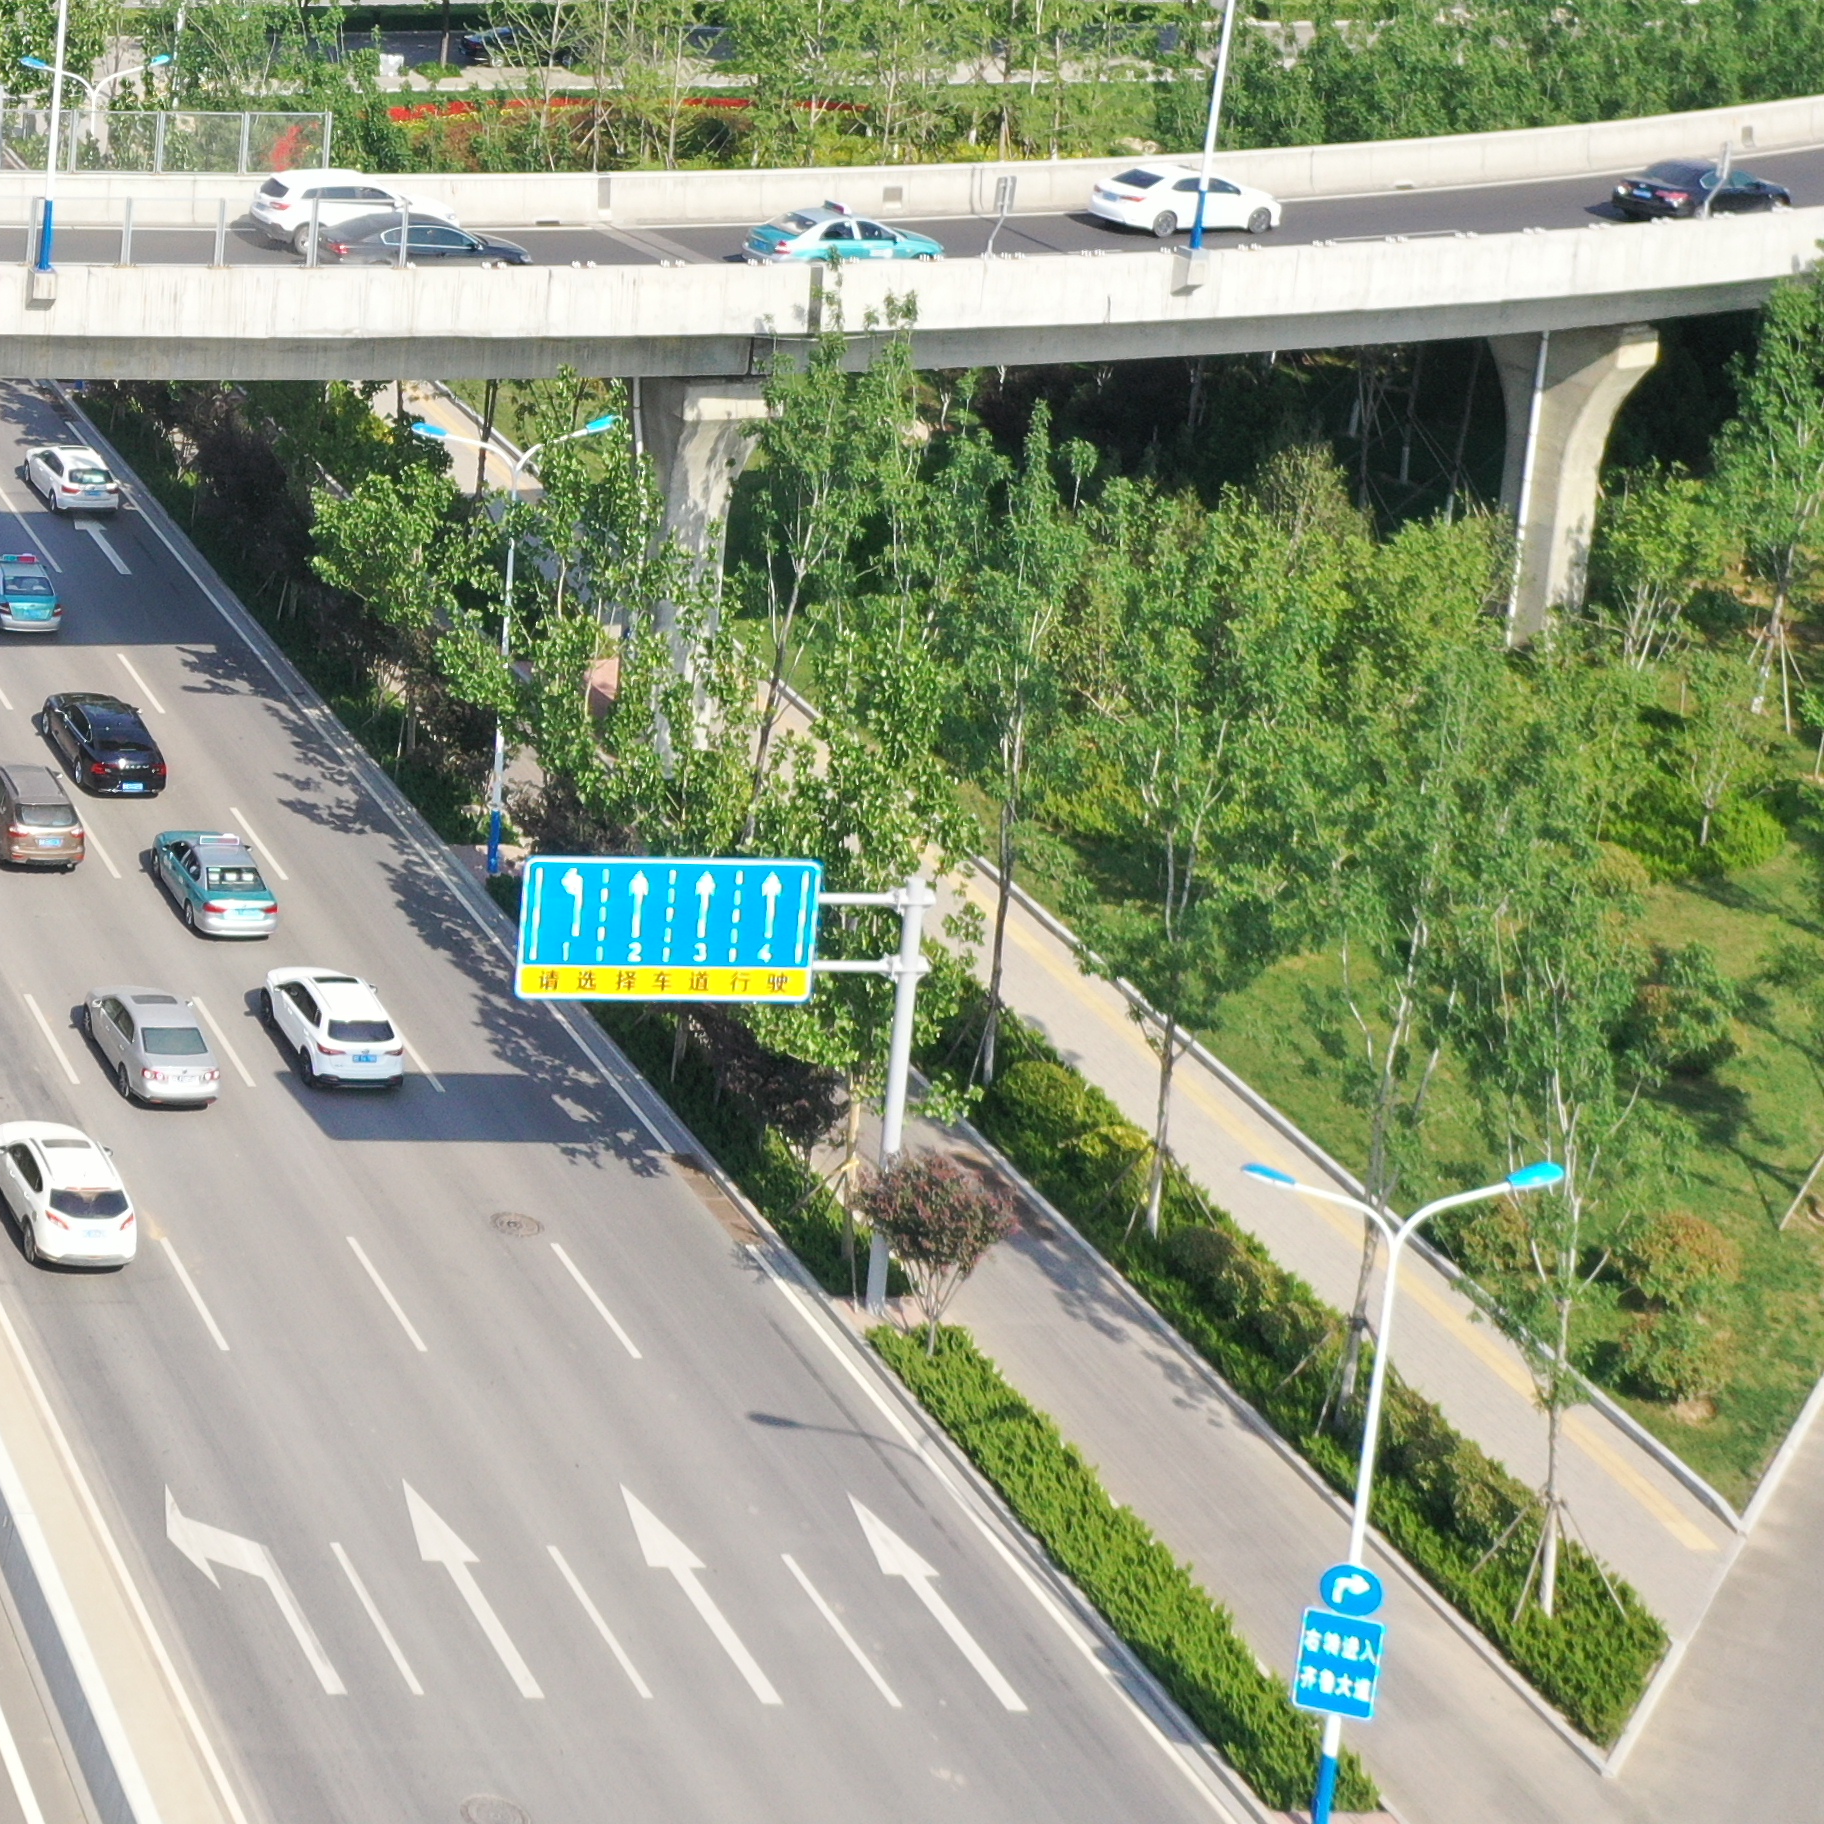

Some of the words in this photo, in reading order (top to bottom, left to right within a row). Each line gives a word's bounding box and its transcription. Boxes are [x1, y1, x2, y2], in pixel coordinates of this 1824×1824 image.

[627, 942, 642, 963] 2
[693, 942, 707, 962] 3
[757, 943, 772, 964] 4
[539, 970, 788, 994] 请选择车道行驶
[1304, 1628, 1376, 1665] 右转进入
[1300, 1665, 1371, 1703] 齐鲁大道
